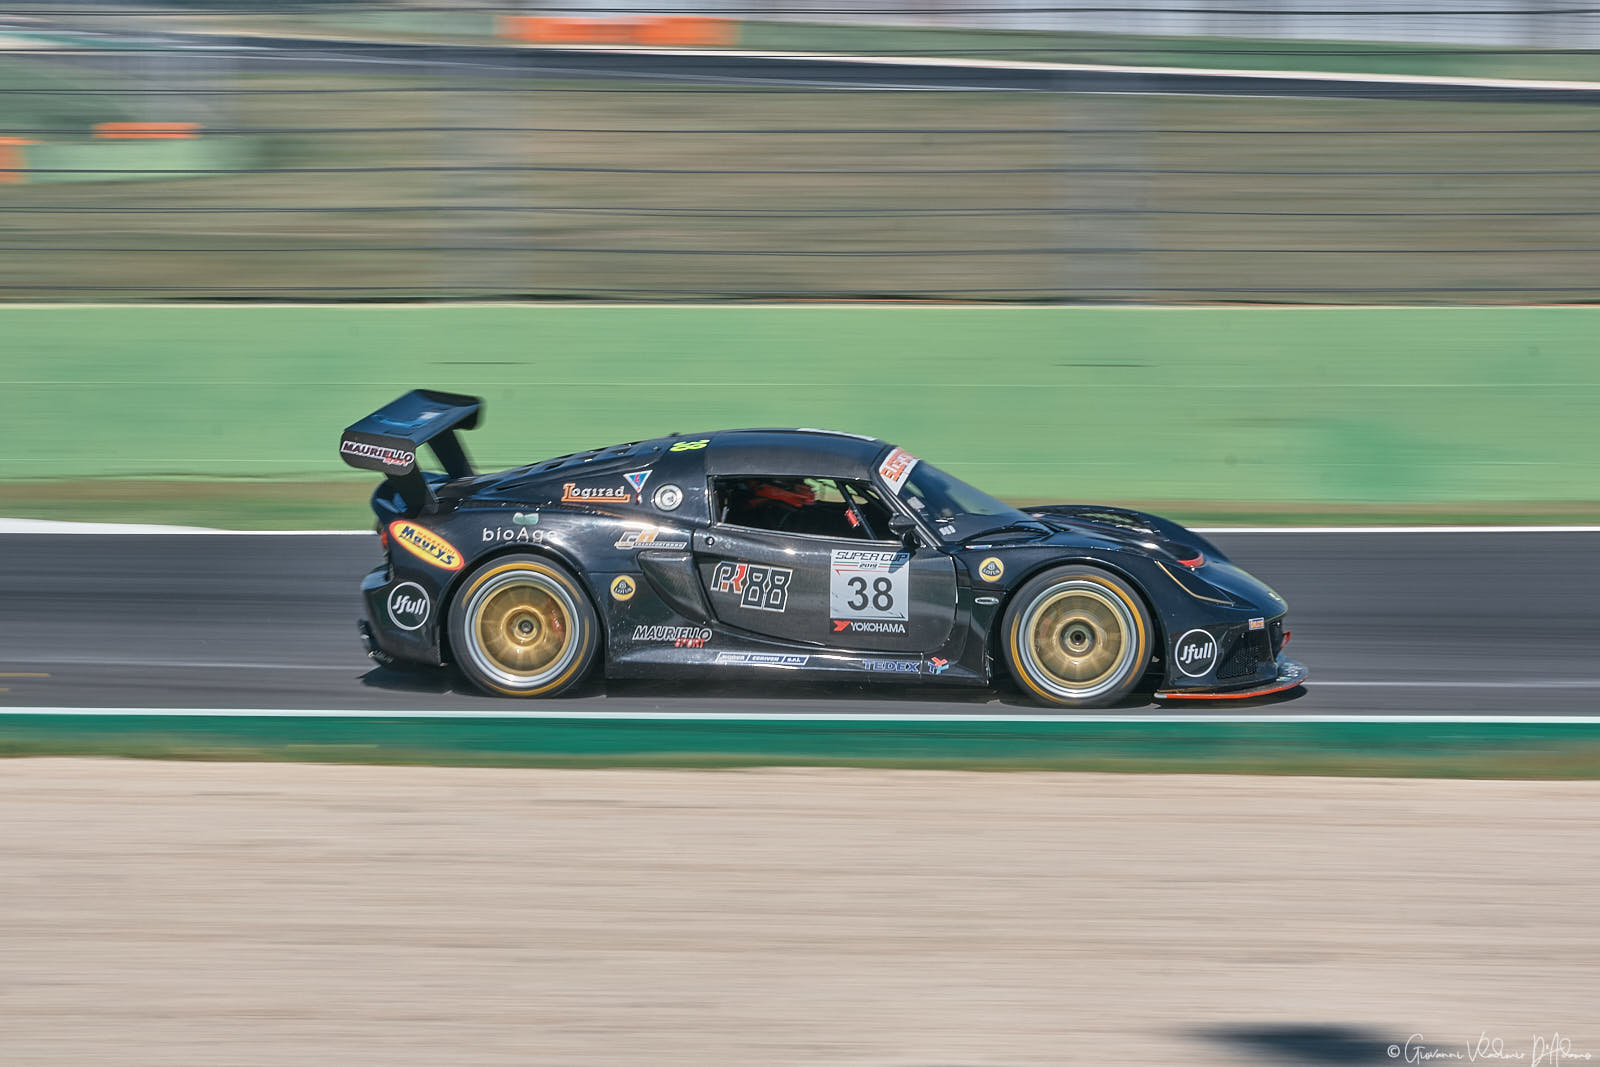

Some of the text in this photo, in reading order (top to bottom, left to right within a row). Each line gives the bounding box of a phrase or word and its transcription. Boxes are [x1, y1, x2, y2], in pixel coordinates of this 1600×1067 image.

[341, 440, 415, 463] MAURIELLO
[835, 551, 909, 562] SUPER CUP
[847, 576, 894, 612] 38
[632, 624, 713, 642] MAURIELLO
[850, 622, 906, 634] YOKOHAMA
[674, 637, 706, 648] SPORT
[862, 658, 920, 673] TEDEX
